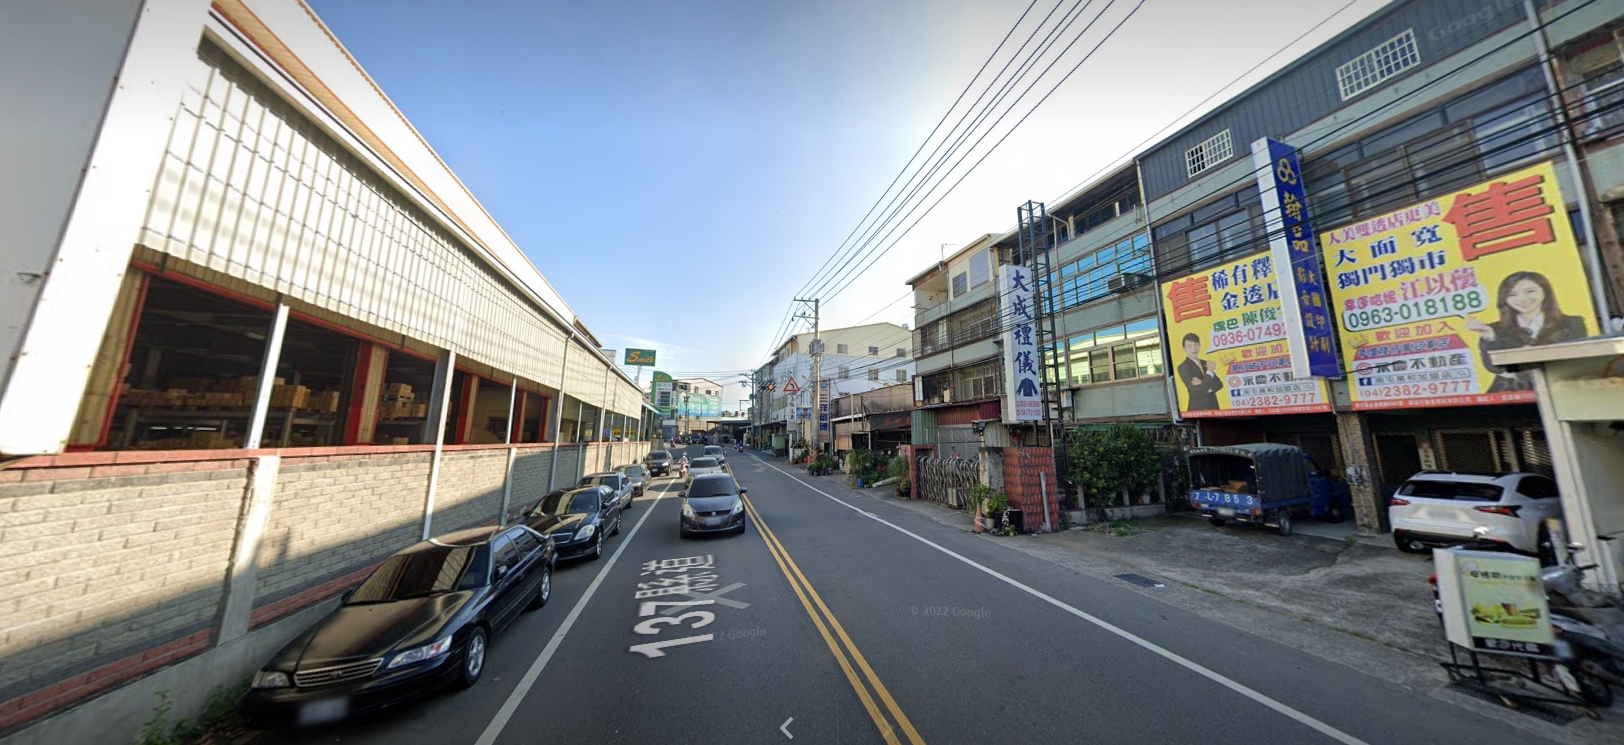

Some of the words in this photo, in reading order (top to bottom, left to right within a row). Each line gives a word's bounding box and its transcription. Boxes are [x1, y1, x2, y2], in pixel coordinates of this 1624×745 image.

[1441, 174, 1556, 262] 售
[1337, 251, 1446, 290] 獨門獨市
[1166, 275, 1212, 324] 售
[1348, 290, 1482, 329] 0963-018188
[1012, 269, 1037, 376] 大成禮儀
[1242, 306, 1281, 327] 陳俊
[1375, 321, 1455, 342] 歡迎加入
[626, 351, 654, 364] Smile
[1376, 352, 1466, 374] 永慶不動產
[1232, 393, 1315, 407] (04)2382-9777
[1360, 380, 1471, 398] (04)2382-9777
